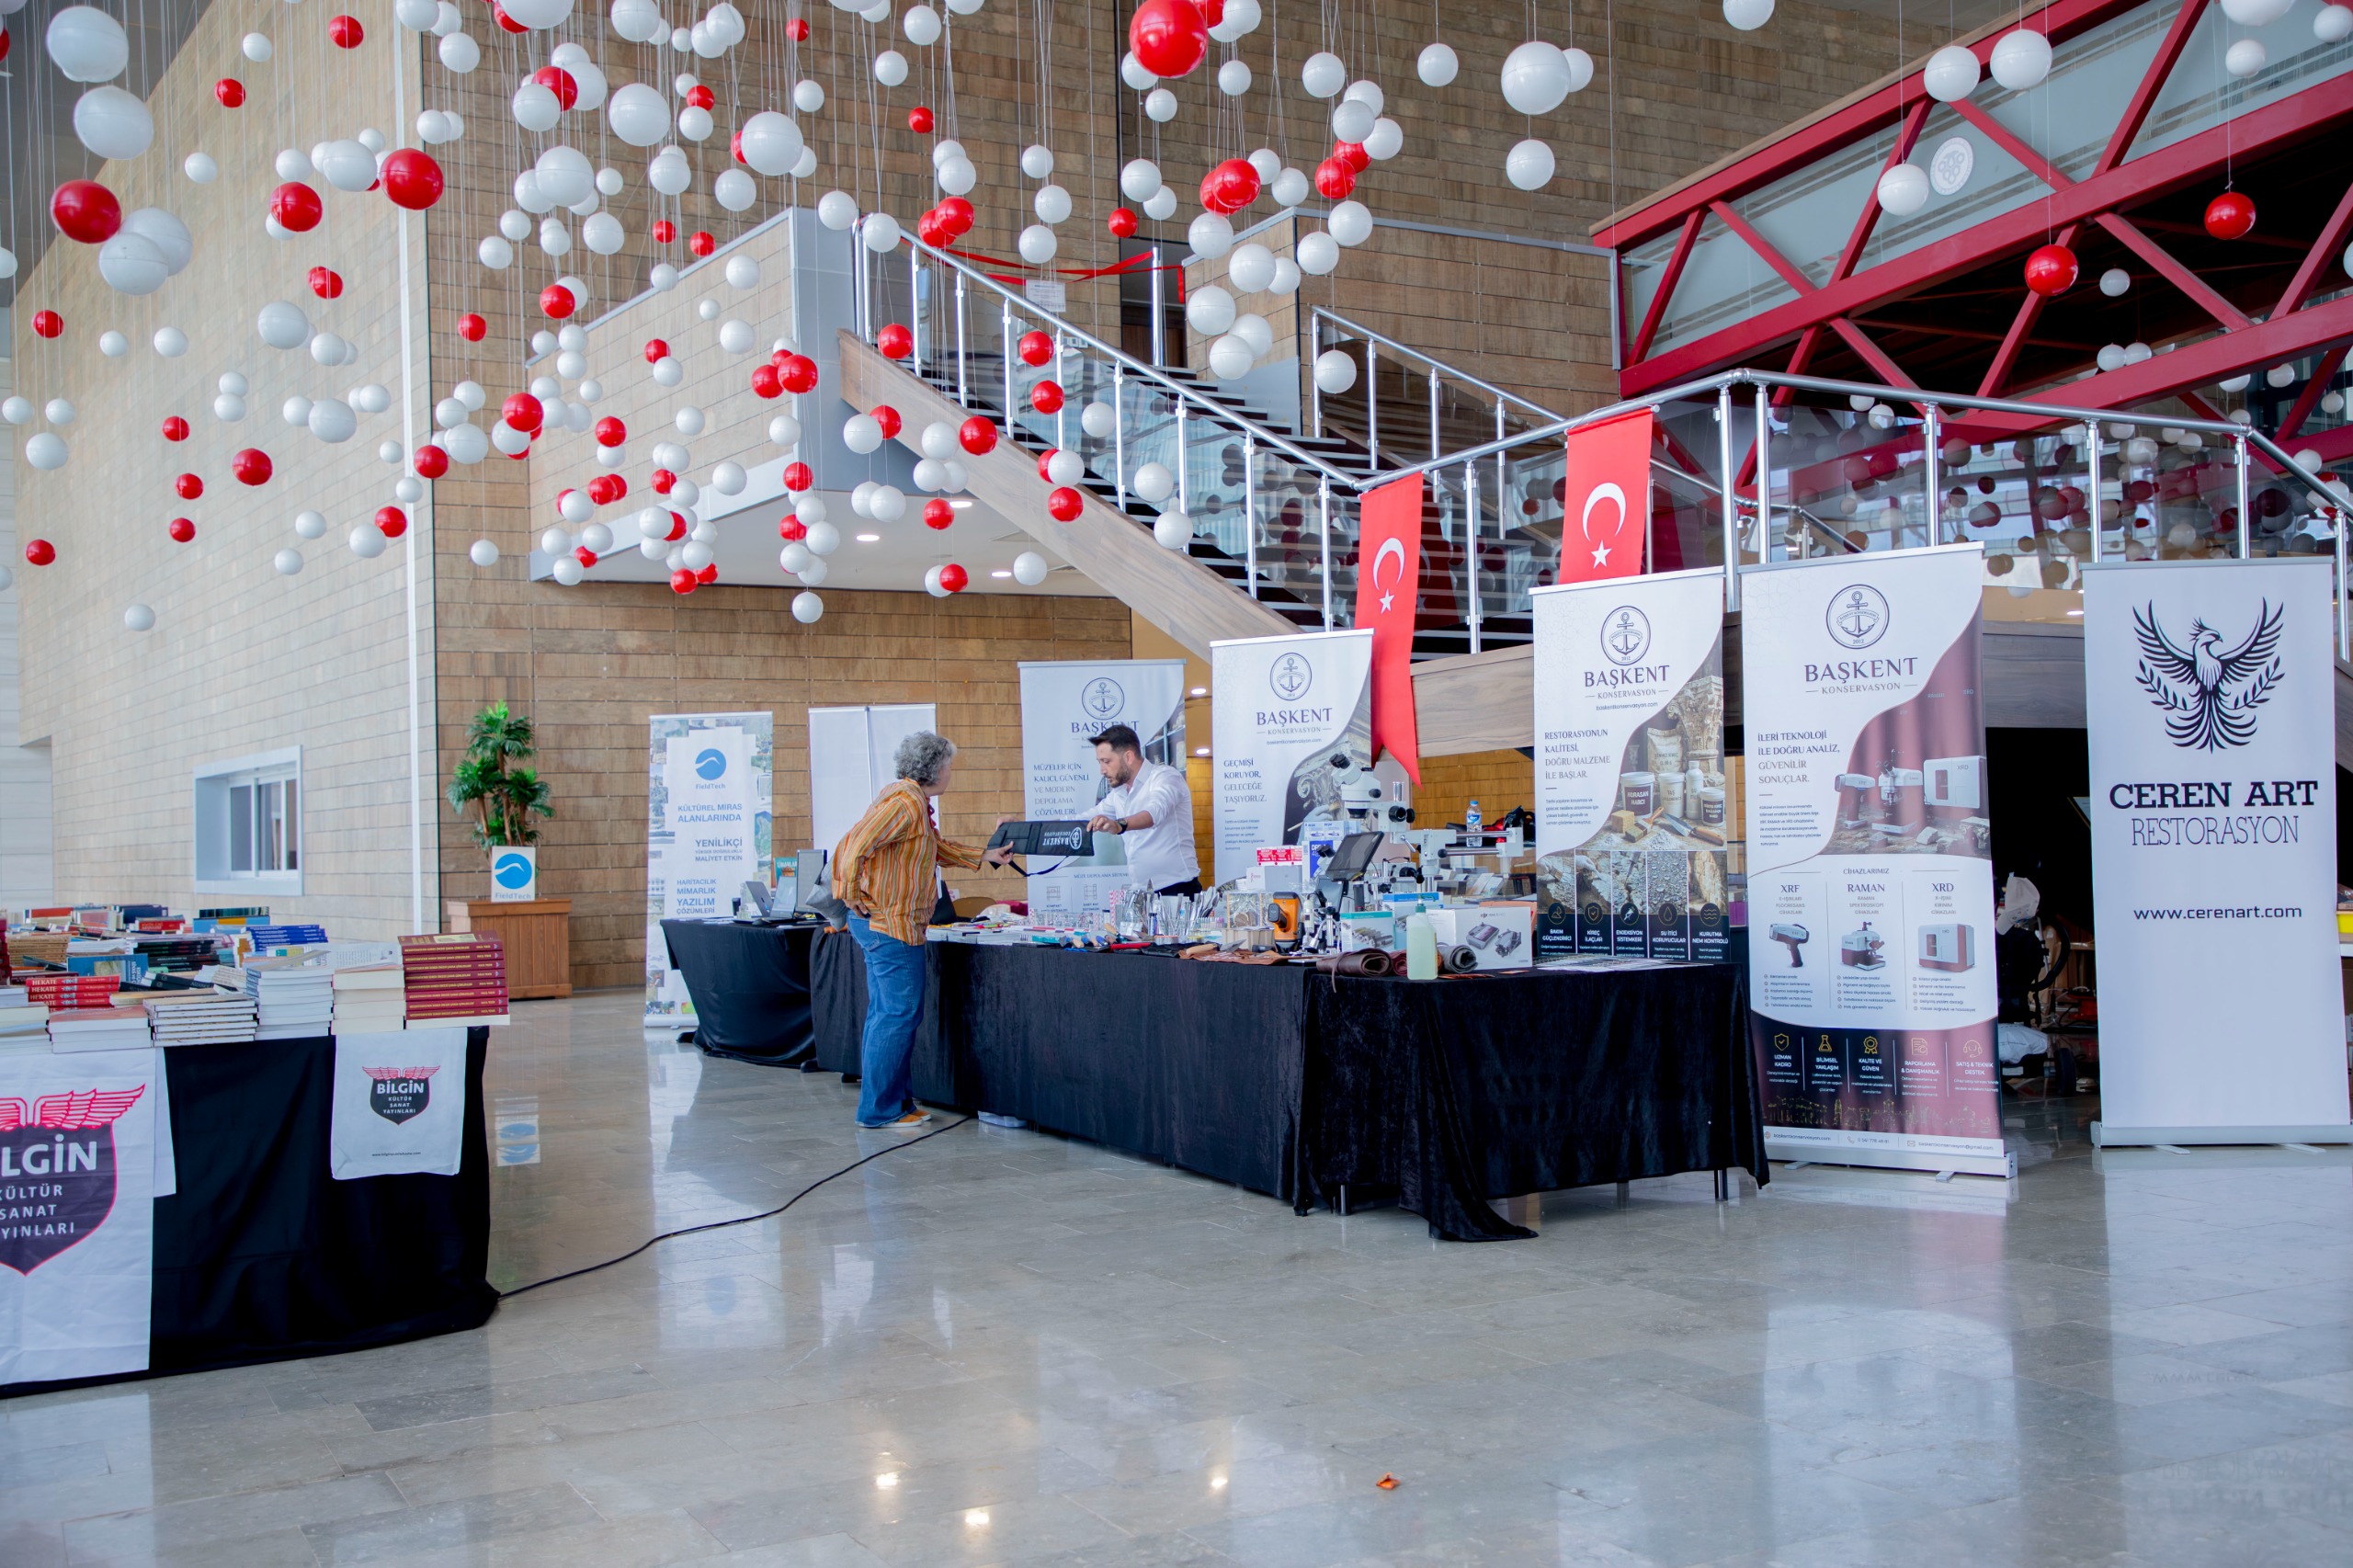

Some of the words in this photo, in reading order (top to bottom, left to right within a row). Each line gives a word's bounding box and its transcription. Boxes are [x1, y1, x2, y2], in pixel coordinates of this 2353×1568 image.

[1803, 656, 1918, 684] BAŞKENT
[1584, 665, 1669, 689] BAŞKENT
[1597, 688, 1656, 699] KONSERVASYON
[1822, 682, 1901, 695] KONSERVASYON
[1256, 708, 1333, 728] BAŞKENT
[1267, 726, 1322, 735] KONSERVASYON
[1544, 729, 1608, 740] RESTORASYONUN
[1757, 732, 1779, 742] İLERİ
[1780, 729, 1827, 741] TEKNOLOJİ
[1544, 743, 1579, 754] KALİTESİ,
[1757, 746, 1771, 756] İLE
[1773, 744, 1805, 756] DOĞRU
[1806, 743, 1840, 754] ANALİZ,
[1067, 762, 1082, 771] İÇİN
[1223, 757, 1254, 768] GEÇMİŞİ
[1545, 756, 1572, 767] DOĞRU
[1574, 756, 1610, 765] MALZEME
[1758, 759, 1807, 770] GÜVENİLİR
[1223, 770, 1262, 779] KORUYOR,
[1545, 770, 1557, 779] İLE
[1559, 770, 1588, 779] BAŞLAR.
[1758, 774, 1810, 785] SONUÇLAR.
[1224, 781, 1263, 791] GELECEĞE
[1224, 794, 1267, 804] TAŞIYORUZ.
[2109, 782, 2232, 810] CEREN
[2244, 780, 2318, 807] ART
[677, 803, 715, 812] KÜLTÜREL
[677, 813, 742, 823] ALANLARINDA
[2131, 815, 2299, 846] RESTORASYON
[695, 836, 743, 849] YENİLİKÇİ
[1042, 836, 1069, 846] BAŞKENT
[1843, 867, 1890, 875] CİHAZLARIMIZ
[676, 886, 716, 895] MİMARLIK
[1780, 884, 1800, 893] XRF
[1847, 883, 1885, 892] RAMAN
[1931, 882, 1954, 892] XRD
[676, 897, 715, 906] YAZILIM
[676, 906, 715, 915] ÇÖZÜMLERİ
[2133, 905, 2302, 920] www.cerenart.com
[377, 1079, 425, 1094] BİLGİN
[0, 1133, 97, 1176] LGİN
[0, 1204, 57, 1221] SANAT
[2, 1222, 75, 1240] YINLARI
